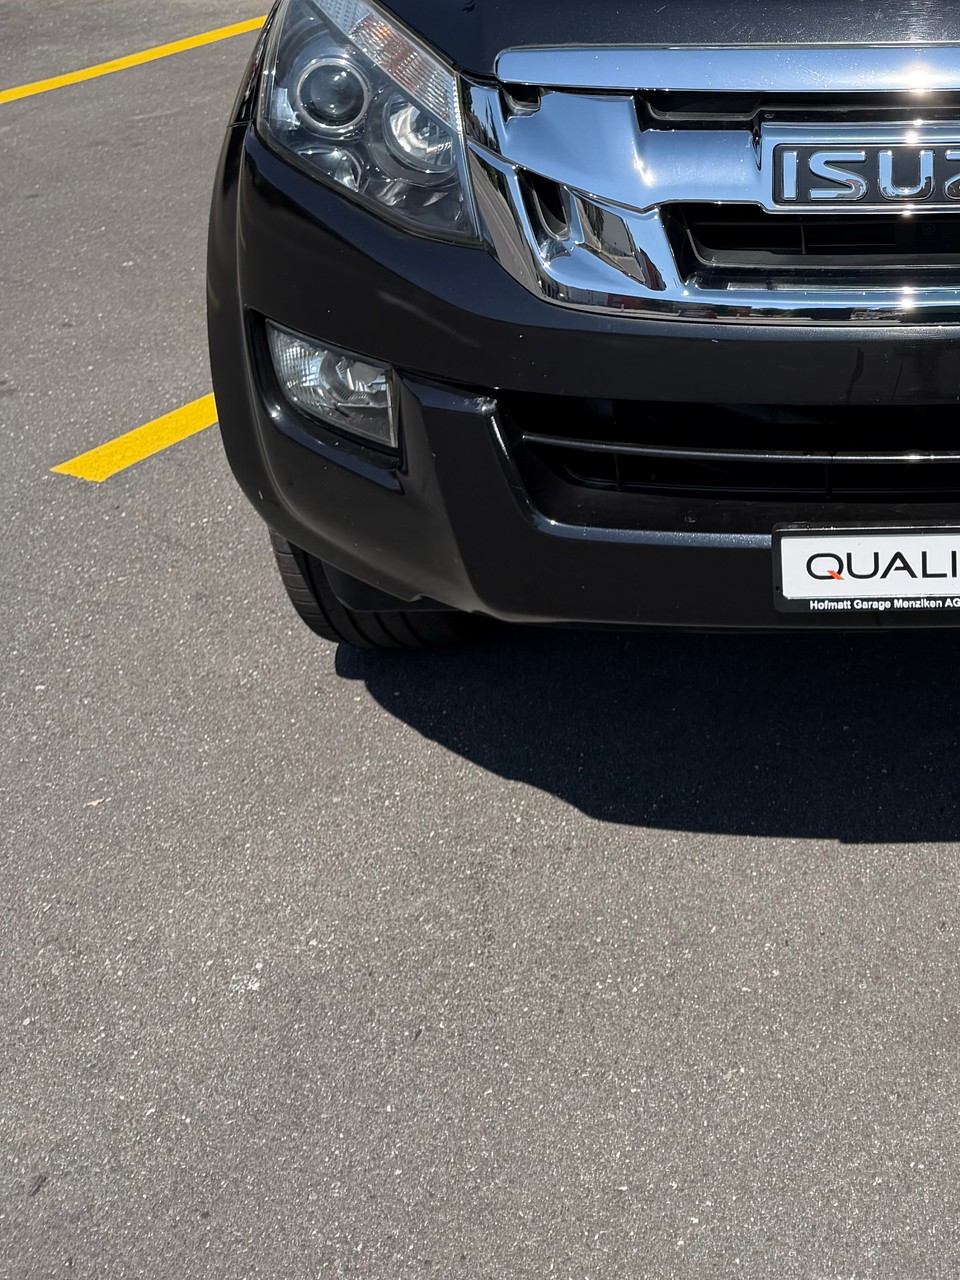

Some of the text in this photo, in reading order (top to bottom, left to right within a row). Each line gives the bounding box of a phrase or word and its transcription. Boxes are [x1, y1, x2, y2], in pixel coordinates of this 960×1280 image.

[809, 599, 852, 611] Hofmatt
[853, 599, 892, 611] Garage
[893, 598, 943, 609] Menziken
